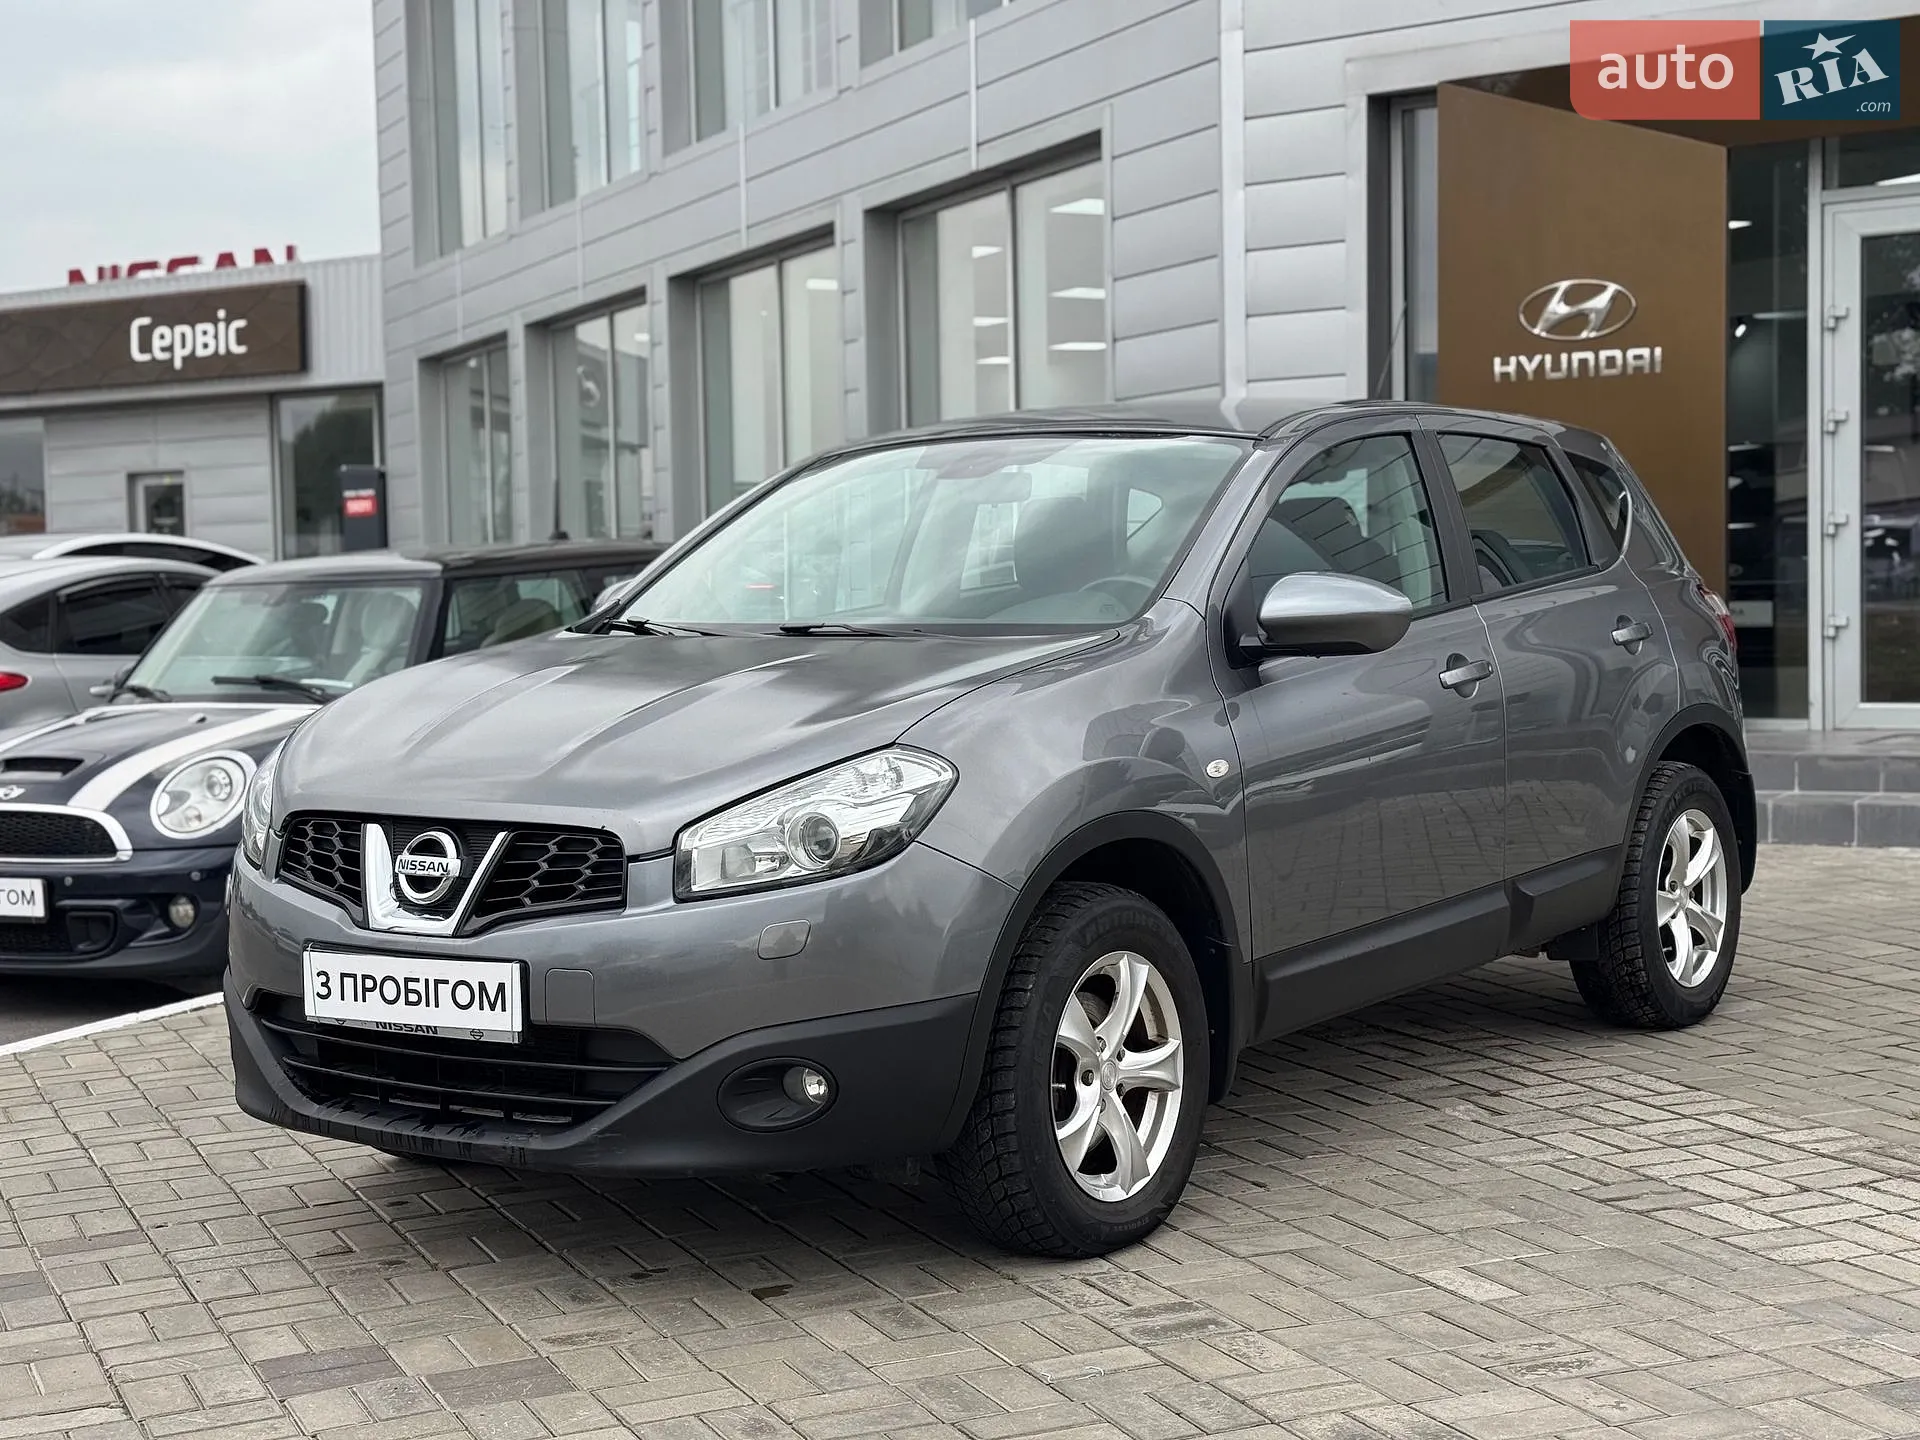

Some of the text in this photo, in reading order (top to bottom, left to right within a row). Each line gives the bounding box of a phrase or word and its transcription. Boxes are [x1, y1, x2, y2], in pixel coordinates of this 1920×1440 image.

[130, 308, 248, 370] Сервіс
[1493, 346, 1662, 382] HYUNDAI
[398, 858, 450, 873] NISSAN
[340, 972, 507, 1013] ПРОБІГОМ
[375, 1021, 439, 1036] NISSAN
